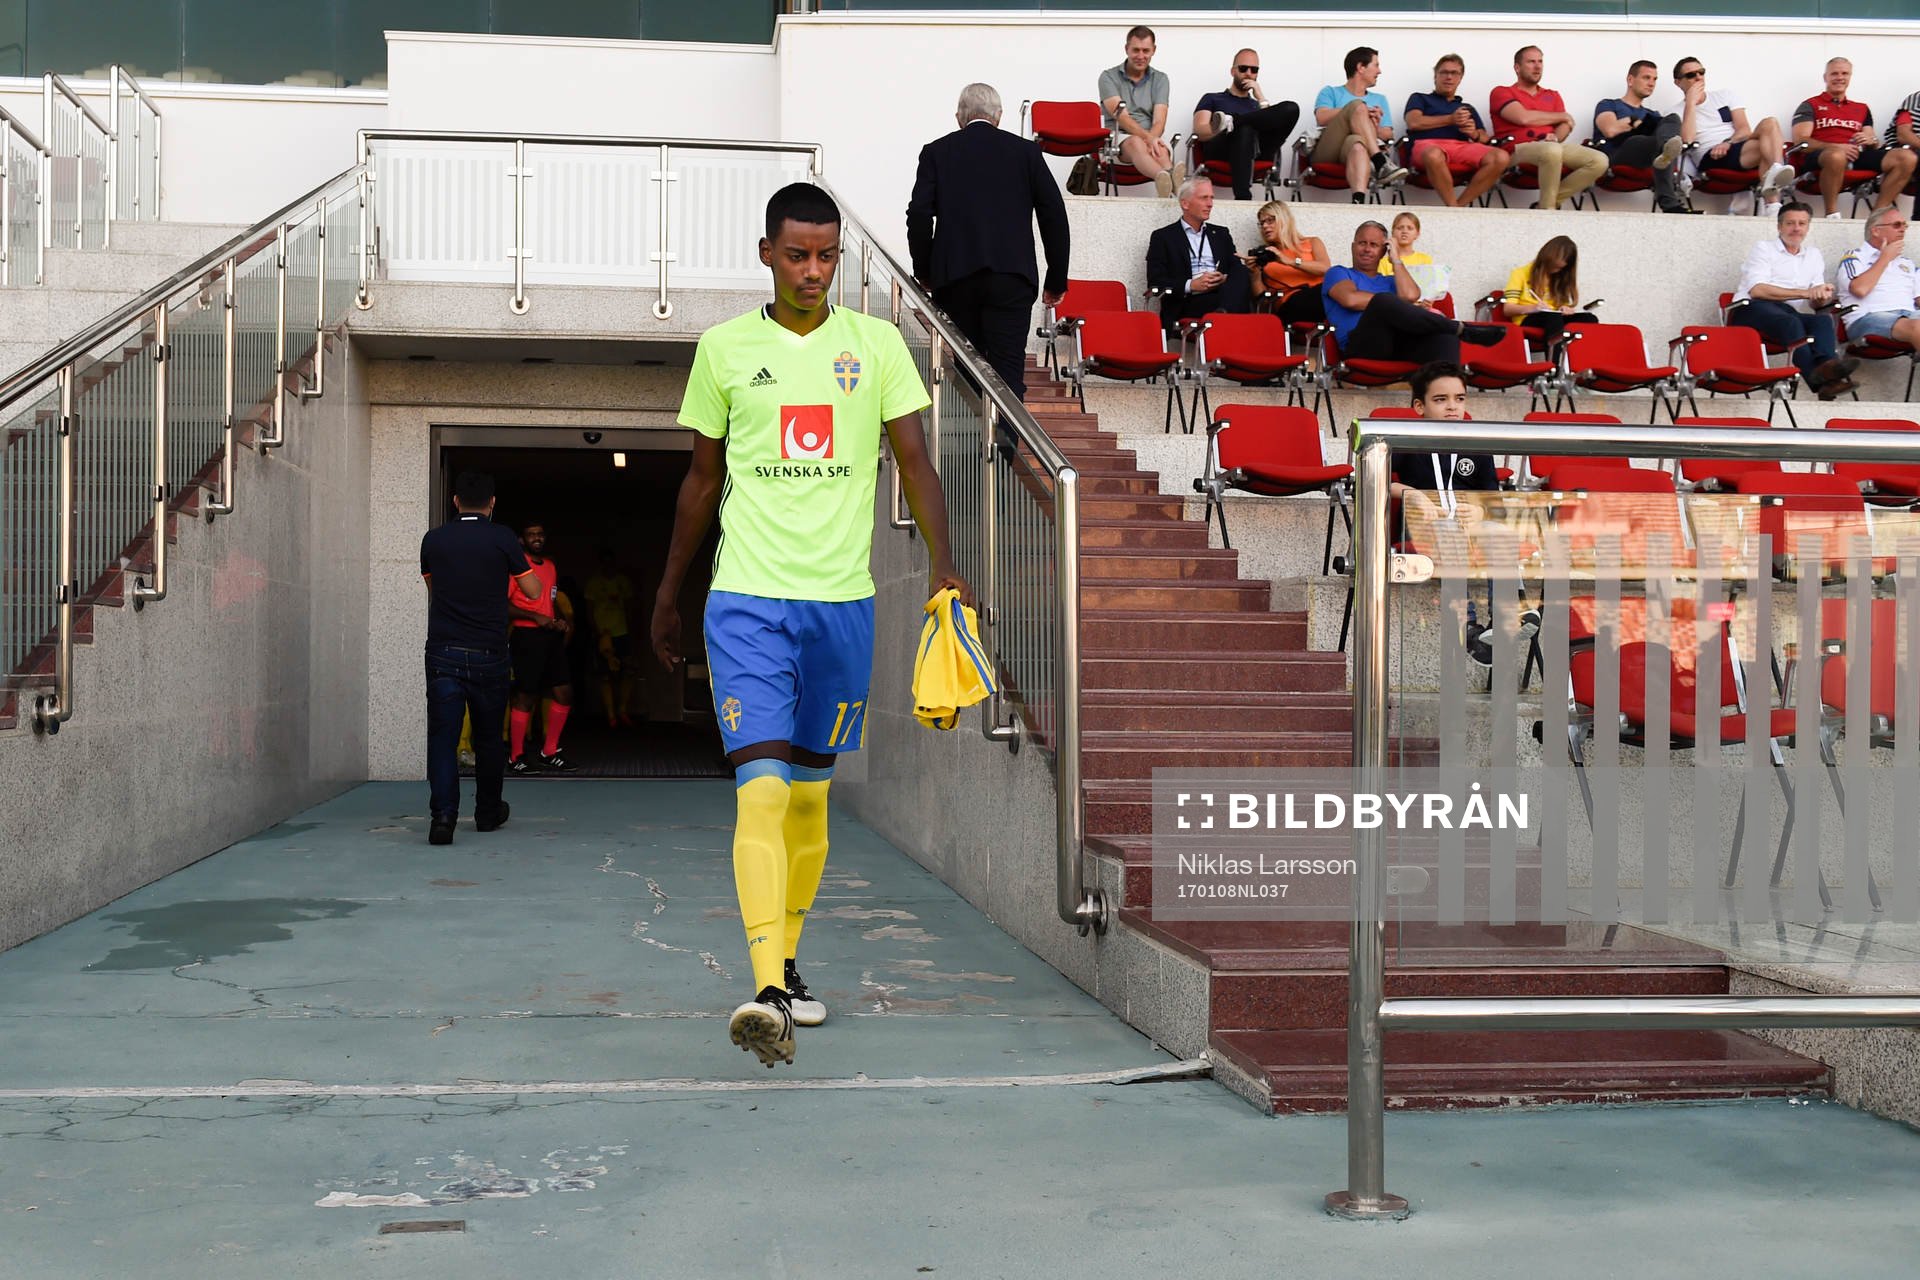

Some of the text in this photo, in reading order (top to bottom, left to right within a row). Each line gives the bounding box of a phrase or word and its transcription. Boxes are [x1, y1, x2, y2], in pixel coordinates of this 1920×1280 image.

[750, 378, 778, 388] adidas
[755, 466, 853, 478] SVENSKA SPE
[828, 701, 863, 747] 17
